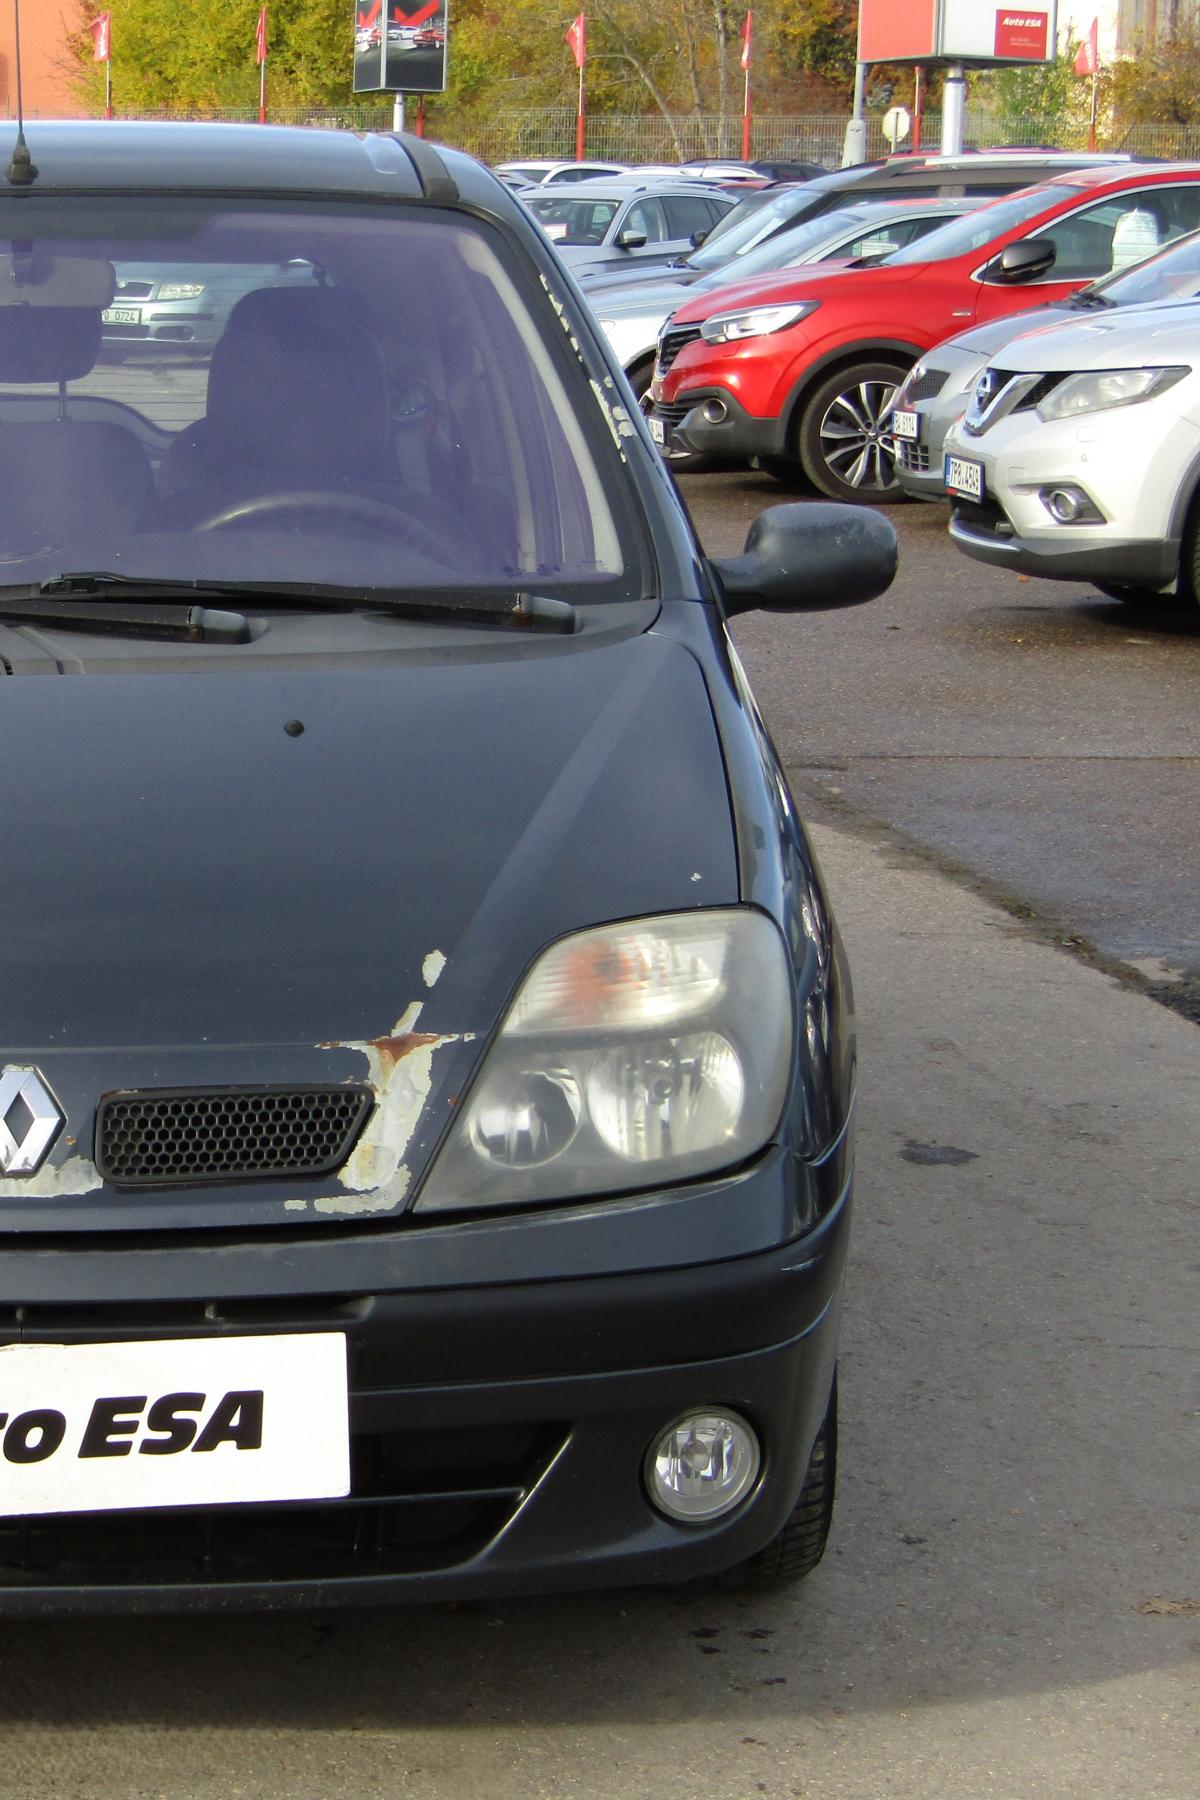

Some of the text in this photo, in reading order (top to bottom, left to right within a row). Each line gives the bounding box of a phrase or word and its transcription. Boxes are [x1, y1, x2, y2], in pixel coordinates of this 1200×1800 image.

[1001, 17, 1041, 27] Auto ESA
[77, 1390, 265, 1459] ESA
